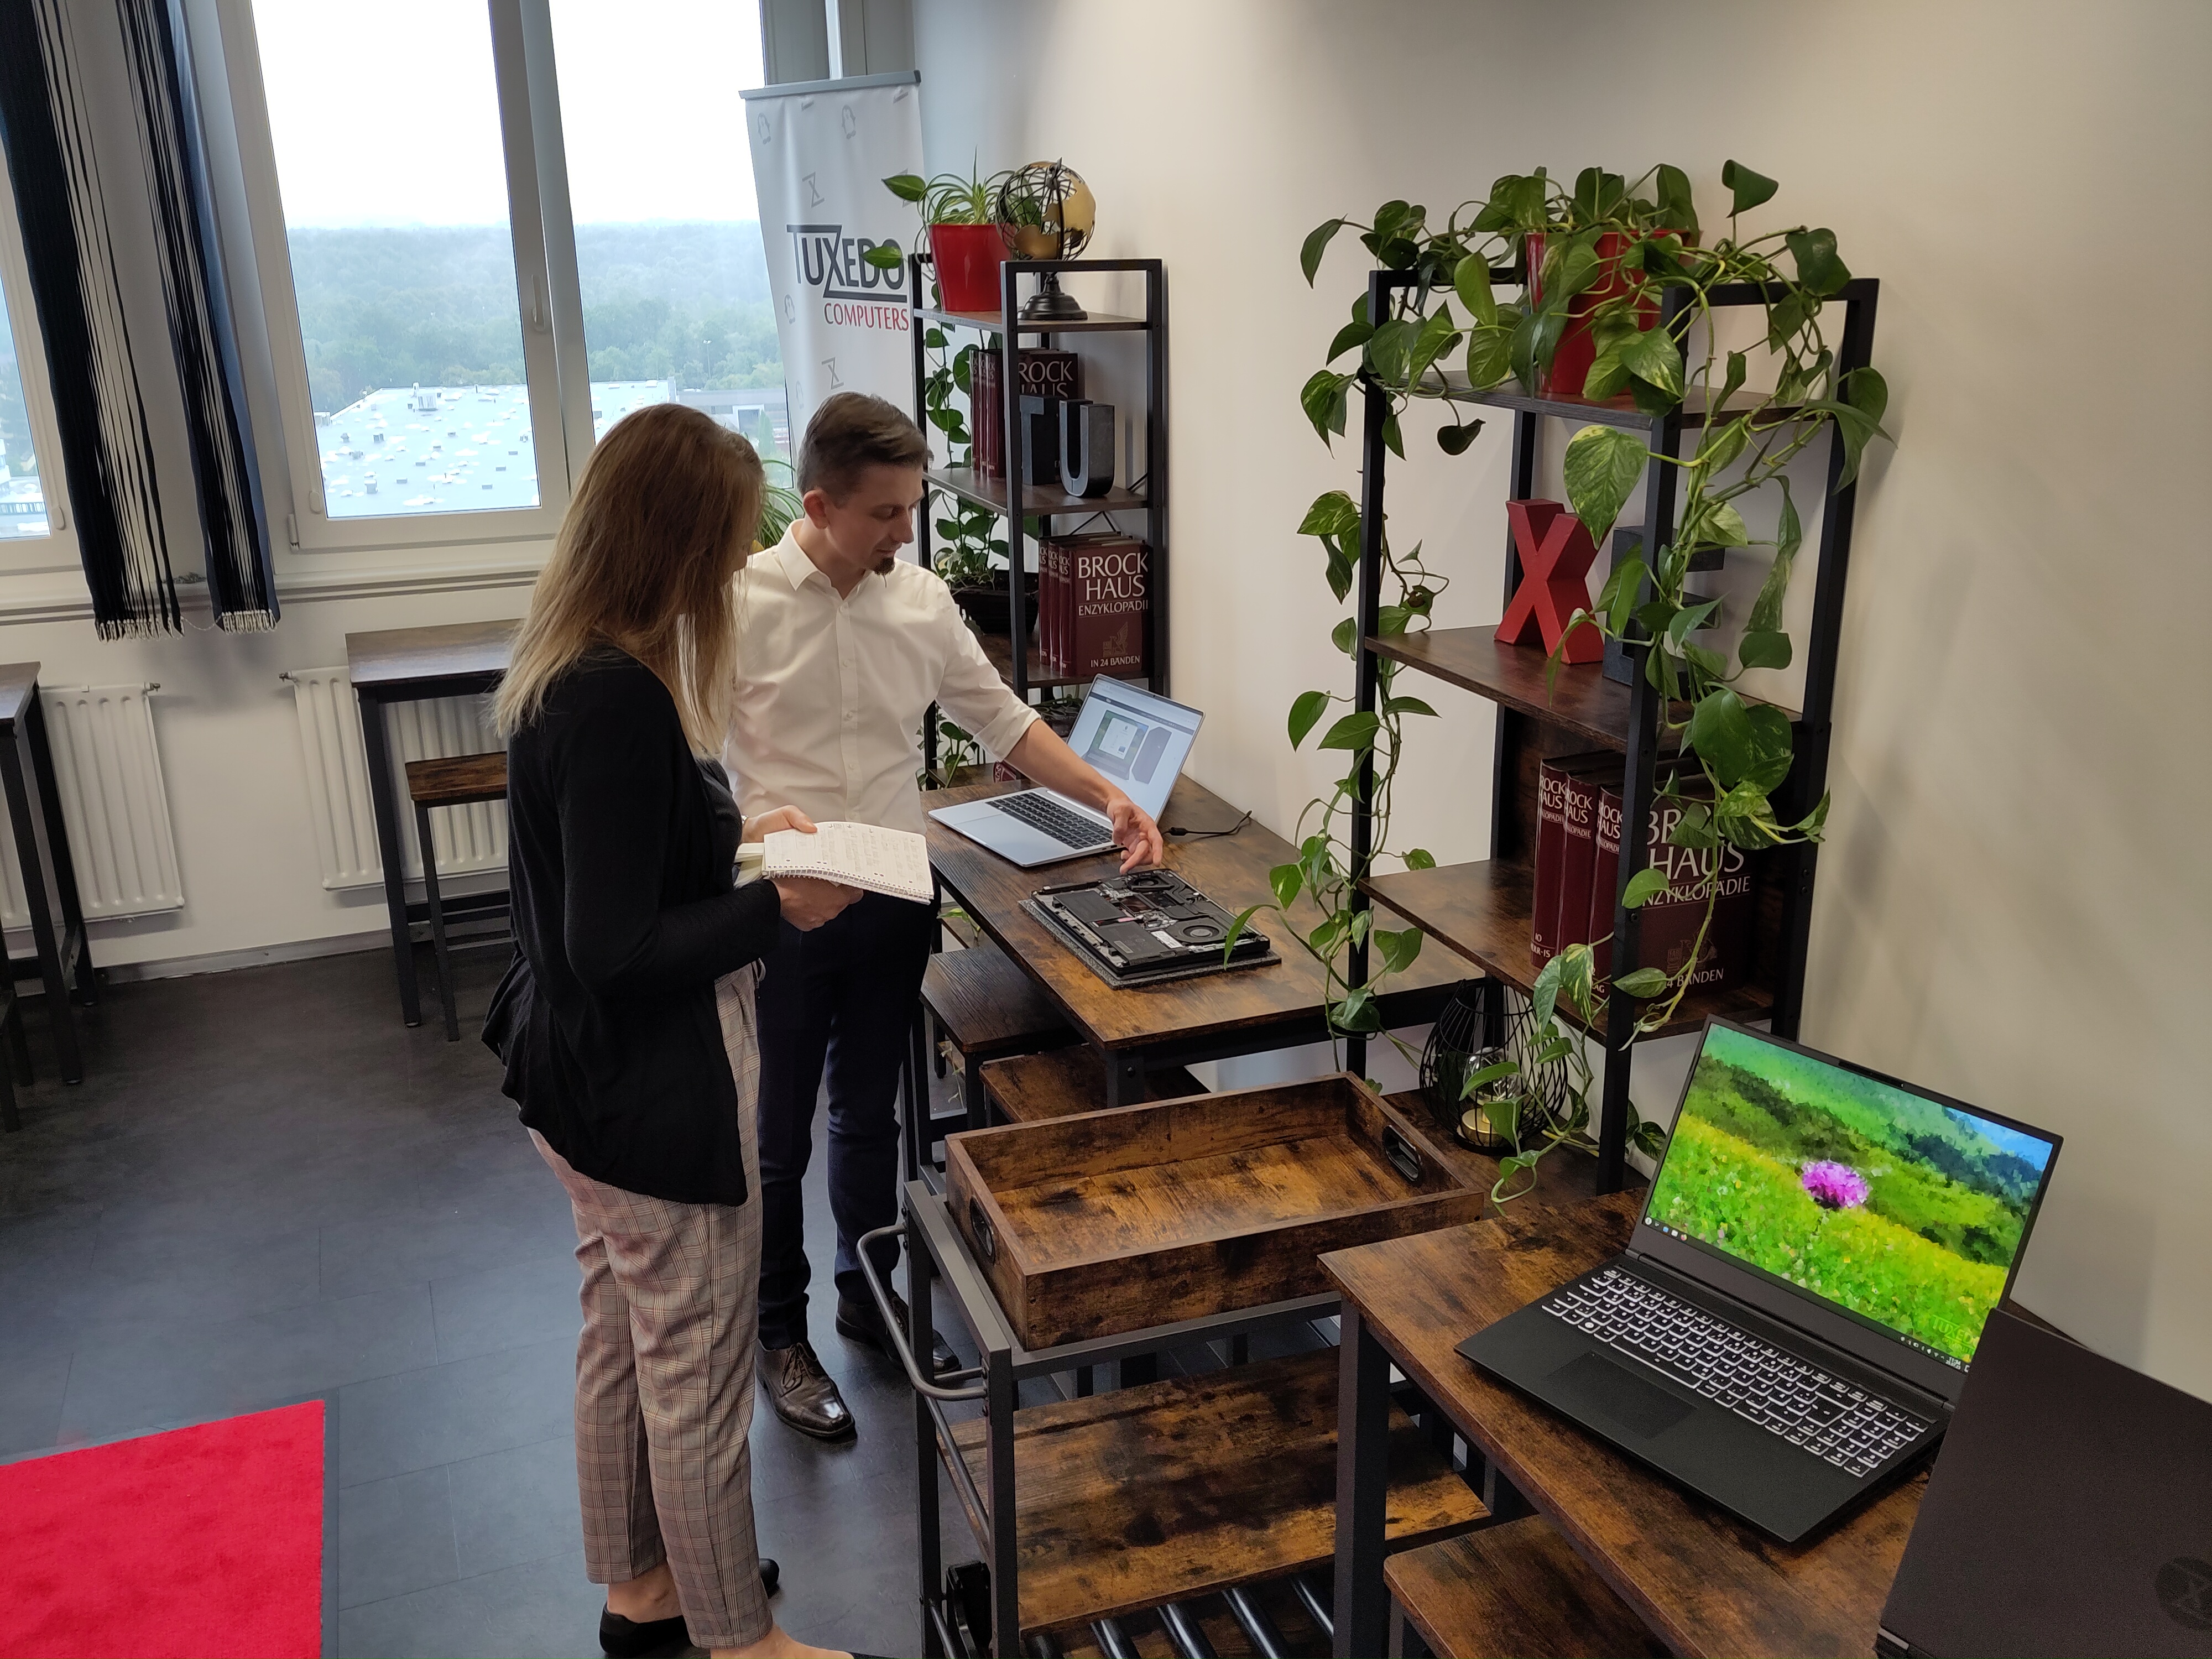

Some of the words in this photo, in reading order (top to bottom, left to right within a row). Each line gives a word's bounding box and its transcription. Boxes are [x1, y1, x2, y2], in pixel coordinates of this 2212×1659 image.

[787, 224, 907, 303] TUXEDO
[824, 302, 909, 331] COMPUTERS
[1019, 361, 1073, 383] ROCK
[1078, 552, 1149, 579] BROCK
[1086, 575, 1145, 601] HAUS
[1091, 659, 1099, 668] IN
[1100, 658, 1108, 667] 24
[1110, 655, 1140, 666] BÄNDEN
[1540, 775, 1567, 795] ROCK
[1648, 841, 1744, 880] HAUS
[1642, 876, 1751, 907] NZYKLOPÄDIE
